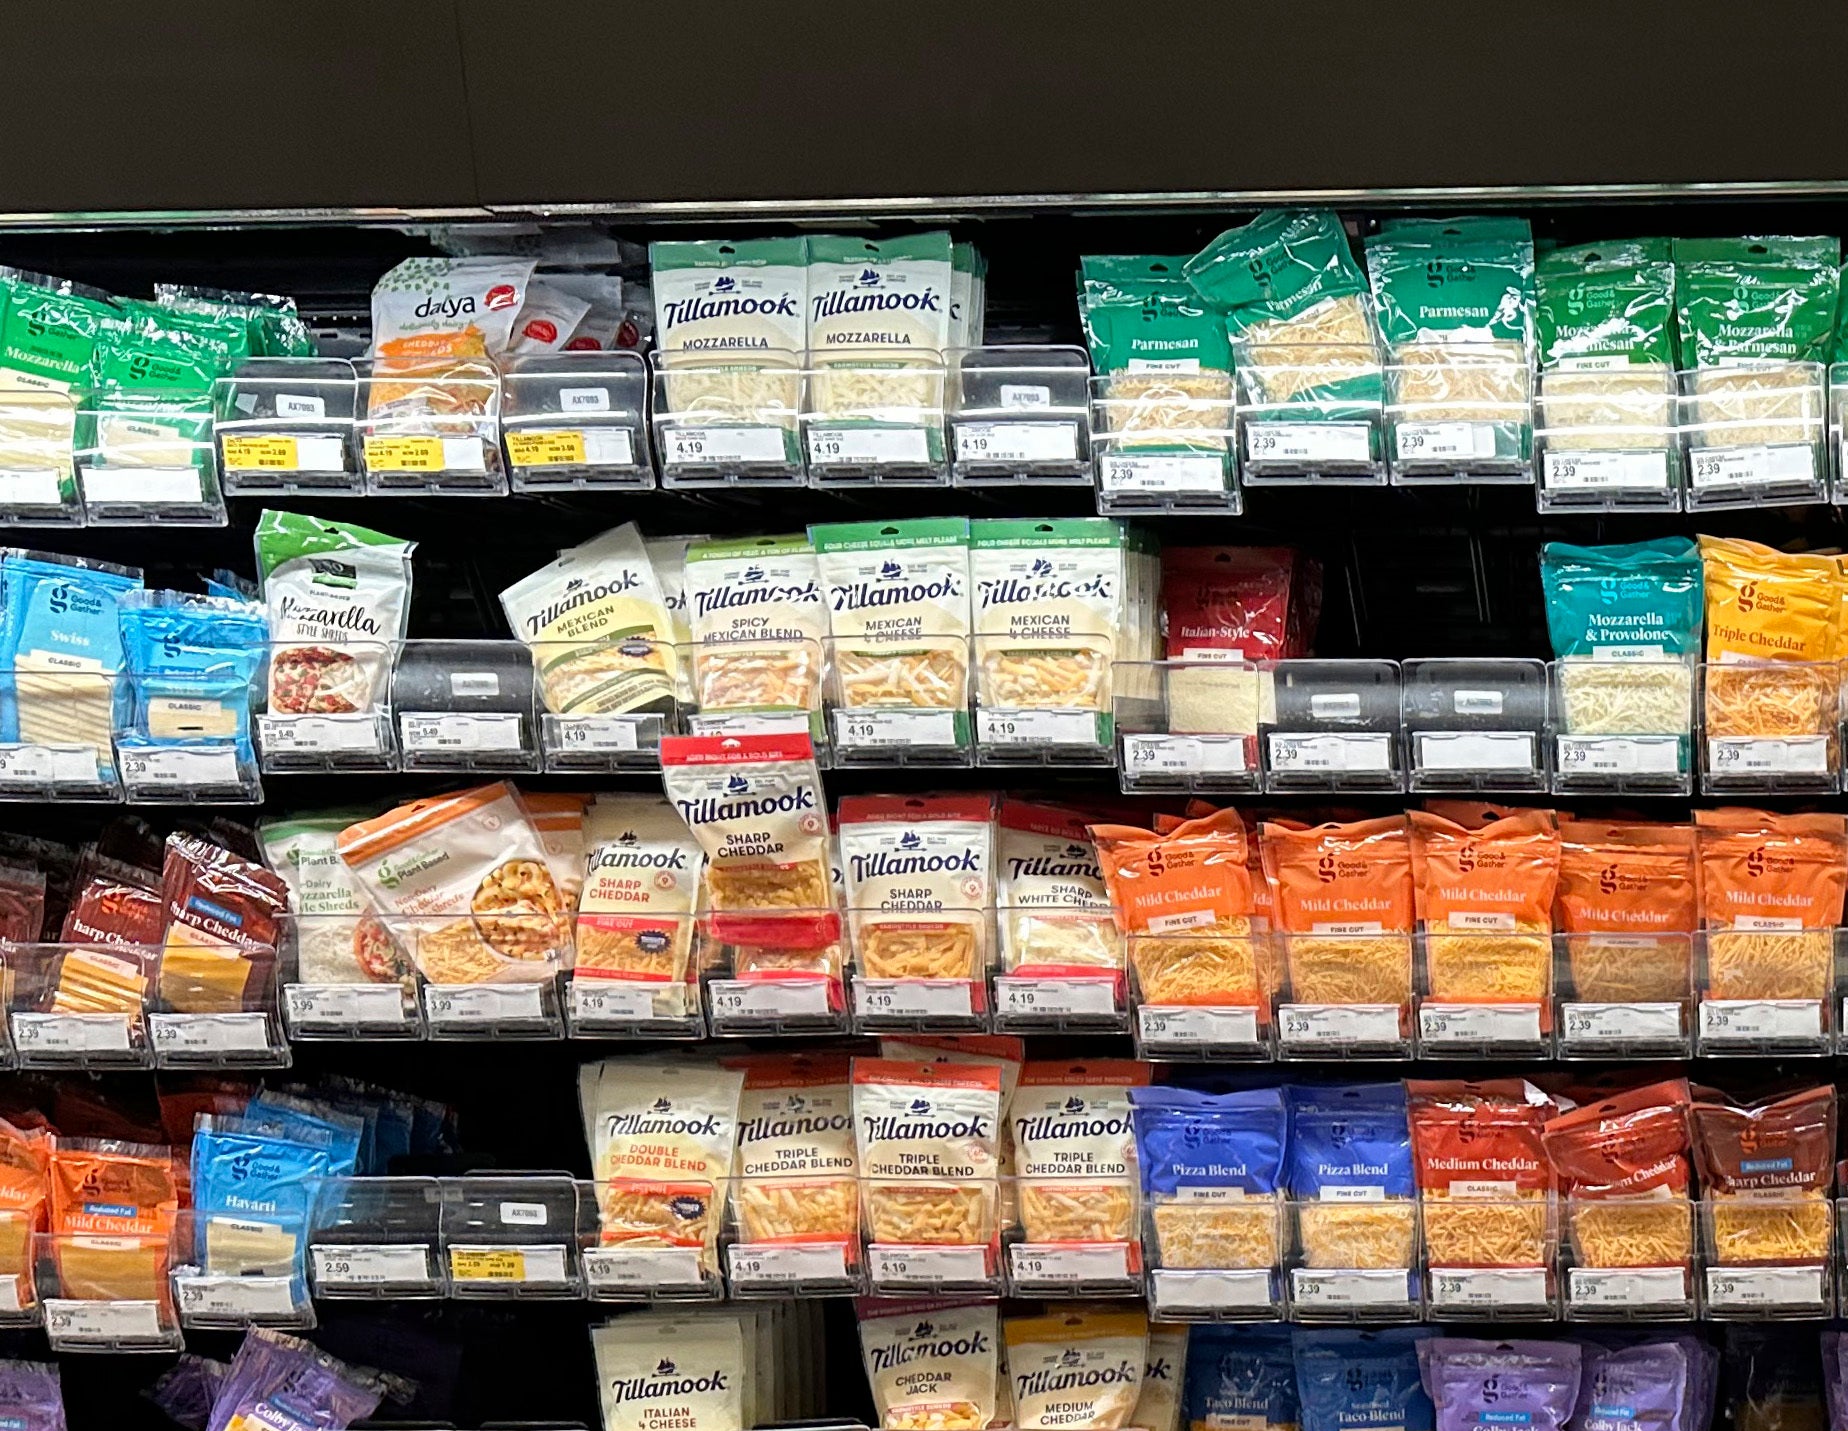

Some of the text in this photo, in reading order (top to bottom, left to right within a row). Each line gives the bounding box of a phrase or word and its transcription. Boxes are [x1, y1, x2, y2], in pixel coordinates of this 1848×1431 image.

[1266, 280, 1322, 312] Parmesan
[664, 293, 796, 329] Tillamook
[812, 287, 939, 323] Tillamook
[1419, 305, 1489, 319] Parmesan
[1719, 324, 1793, 338] Mozzarella
[682, 337, 768, 351] MOZZARELLA
[826, 331, 911, 345] MOZZARELLA
[1131, 337, 1199, 351] Parmesan
[4, 346, 80, 374] Mozzarella
[676, 441, 703, 454] 4.19
[962, 438, 987, 450] 4.19
[1402, 435, 1424, 447] 2.39
[933, 536, 958, 544] PLEASE
[832, 572, 961, 611] Tillamook
[1621, 590, 1650, 599] Gather
[71, 594, 102, 606] Good&
[527, 570, 638, 636] Tillamook
[70, 603, 99, 614] Gather
[557, 605, 614, 634] MEXICAN
[732, 618, 770, 629] SPICY
[866, 617, 922, 631] MEXICAN
[1011, 615, 1070, 626] MEXICAN
[1588, 613, 1664, 626] Mozzarella
[297, 624, 318, 637] STYLE
[568, 617, 609, 637] BLEND
[1021, 627, 1071, 640] CHEESE
[1181, 626, 1249, 639] Italian-Style
[50, 629, 90, 646] Swiss
[703, 629, 803, 644] MEXICAN BLEND
[1585, 627, 1669, 642] & Provolone
[1713, 624, 1806, 653] Triple Cheddar
[48, 657, 81, 668] CLASSIC
[168, 703, 201, 711] CLASSIC
[848, 724, 874, 736] 4.19
[125, 761, 146, 773] 2.39
[678, 787, 813, 826] Tillamook
[726, 833, 770, 845] SHARP
[718, 843, 784, 858] CHEDDAR
[397, 852, 450, 880] Plant Based
[851, 848, 980, 882] Tillamook
[1477, 860, 1506, 868] Gather
[599, 879, 641, 888] SHARP
[589, 890, 650, 902] CHEDDAR
[890, 889, 932, 900] SHARP
[1135, 885, 1221, 908] Mild Cheddar
[1440, 888, 1526, 903] Mild Cheddar
[1725, 891, 1813, 907] Mild Cheddar
[881, 901, 942, 914] CHEDDAR
[1300, 897, 1391, 911] Mild Cheddar
[170, 901, 201, 927] Sharp
[1165, 915, 1197, 926] FINE CUT
[1464, 916, 1498, 924] FINE CUT
[717, 996, 741, 1006] 4.19
[1145, 1021, 1166, 1032] 2.39
[608, 1114, 721, 1136] Tillamook
[630, 1144, 678, 1156] DOUBLE
[610, 1154, 706, 1172] CHEDDAR BLEND
[899, 1153, 940, 1164] TRIPLE
[1427, 1158, 1539, 1170] Medium Cheddar
[872, 1163, 974, 1176] CHEDDAR BLEND
[1172, 1164, 1246, 1176] Pizza Blend
[226, 1195, 276, 1213] Havarti
[65, 1215, 153, 1234] Mild Cheddar
[326, 1263, 350, 1273] 2.59
[735, 1262, 759, 1271] 4.19
[895, 1372, 952, 1386] CHEDDAR
[612, 1370, 728, 1404] Tillamook
[906, 1383, 937, 1395] JACK
[644, 1407, 690, 1418] ITALIAN
[1046, 1401, 1093, 1413] MEDIUM
[255, 1402, 290, 1429] Colby
[1040, 1411, 1095, 1425] CHEDDAR
[1339, 1409, 1405, 1422] Taco Blend
[639, 1418, 697, 1429] 4 CHEESE
